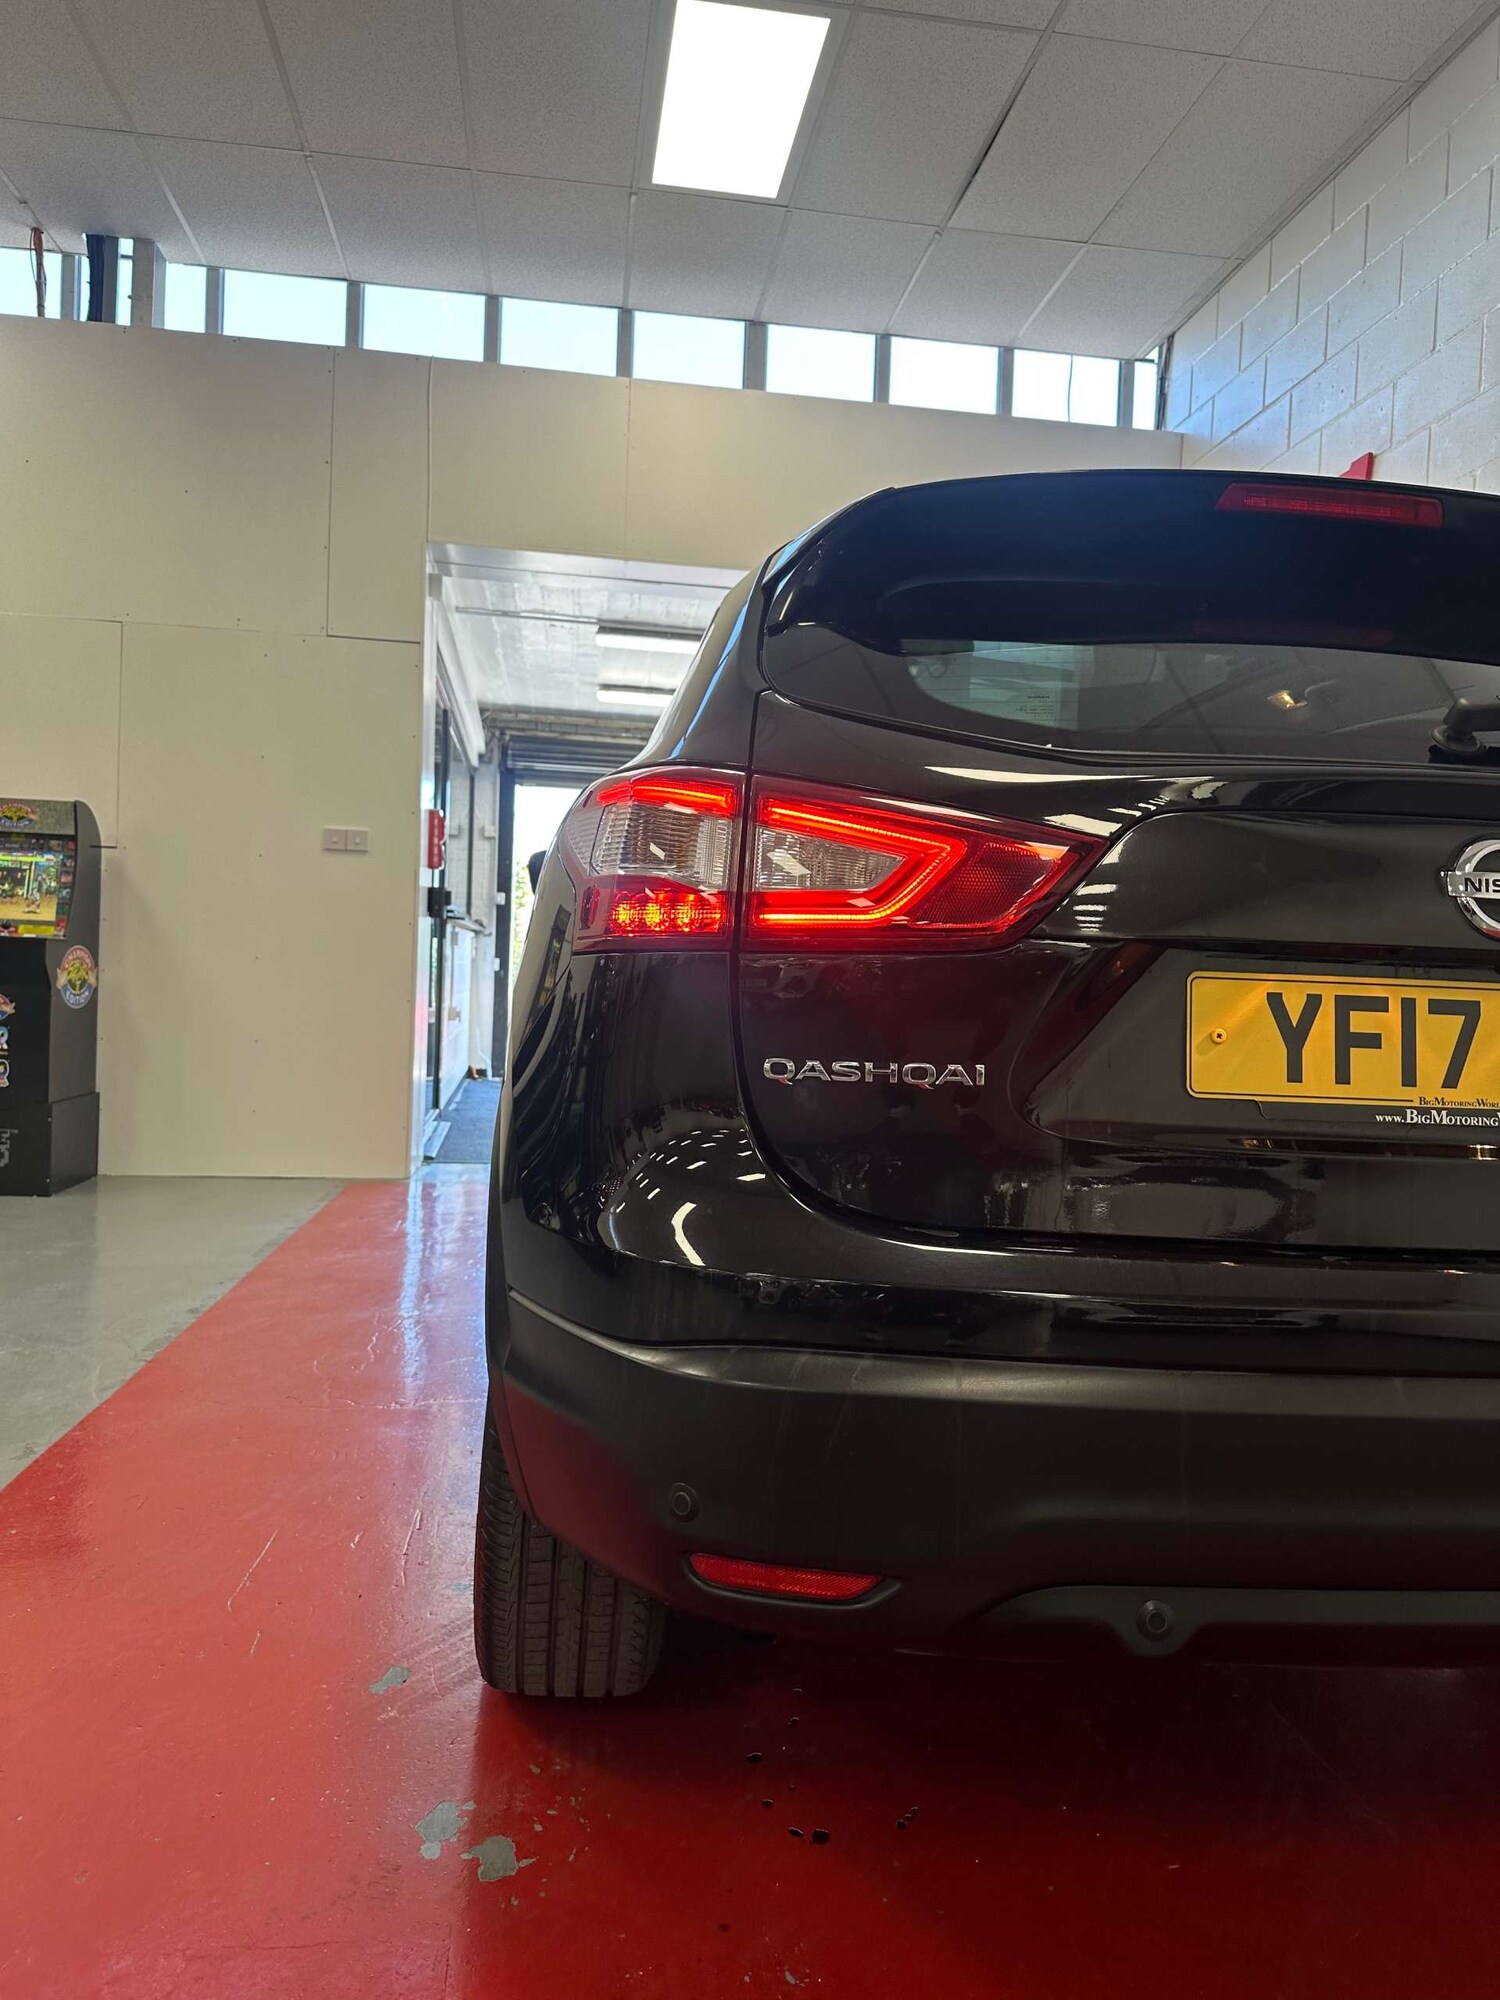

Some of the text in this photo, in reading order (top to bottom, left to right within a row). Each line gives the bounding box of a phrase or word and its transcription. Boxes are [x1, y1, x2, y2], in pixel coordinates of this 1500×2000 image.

[1266, 991, 1481, 1089] YF17
[763, 1057, 985, 1089] QASHQAI
[1375, 1108, 1500, 1126] www.BIGMOTORING
